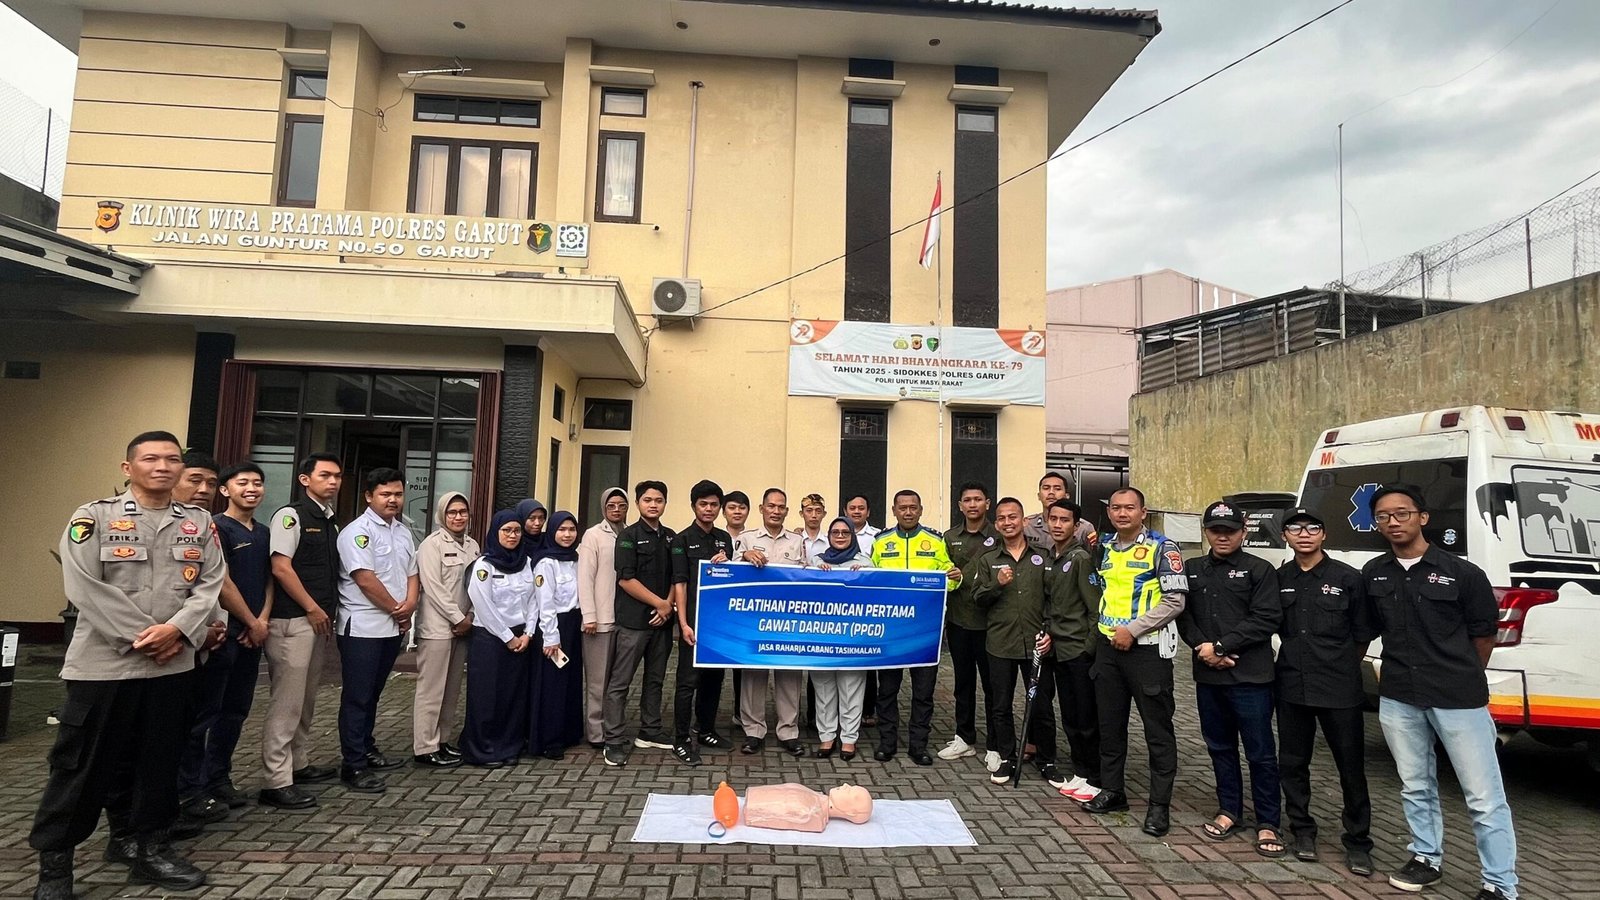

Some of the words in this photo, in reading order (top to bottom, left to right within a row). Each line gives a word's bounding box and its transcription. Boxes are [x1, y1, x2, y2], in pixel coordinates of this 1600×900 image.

[129, 203, 202, 229] KLINIK
[208, 207, 261, 232] WIRA
[269, 211, 364, 237] PRATAMA
[369, 216, 447, 242] POLRES
[454, 220, 524, 245] GARUT
[151, 231, 229, 246] JALAN
[237, 235, 329, 251] GUNTUR
[337, 239, 405, 255] NO.50
[417, 244, 495, 260] GARUT
[815, 352, 870, 364] SELAMAT
[872, 355, 900, 366] HARI
[902, 356, 988, 370] BHAYANGKARA
[1011, 361, 1023, 370] 79
[833, 366, 863, 374] TAHUN
[865, 367, 886, 375] 2025
[893, 368, 938, 378] SIDOKKES
[940, 371, 974, 379] POLRES
[728, 597, 787, 614] PELATIHAN
[787, 599, 863, 617] PERTOLONGAN
[865, 602, 916, 618] PERTAMA
[758, 618, 798, 633] GAWAT
[798, 619, 849, 635] DARURAT
[850, 621, 885, 638] (PPGD)
[758, 643, 774, 653] JASA
[775, 643, 806, 654] RAHARJA
[806, 644, 834, 654] CABANG
[834, 645, 882, 655] TASIKMALAYA
